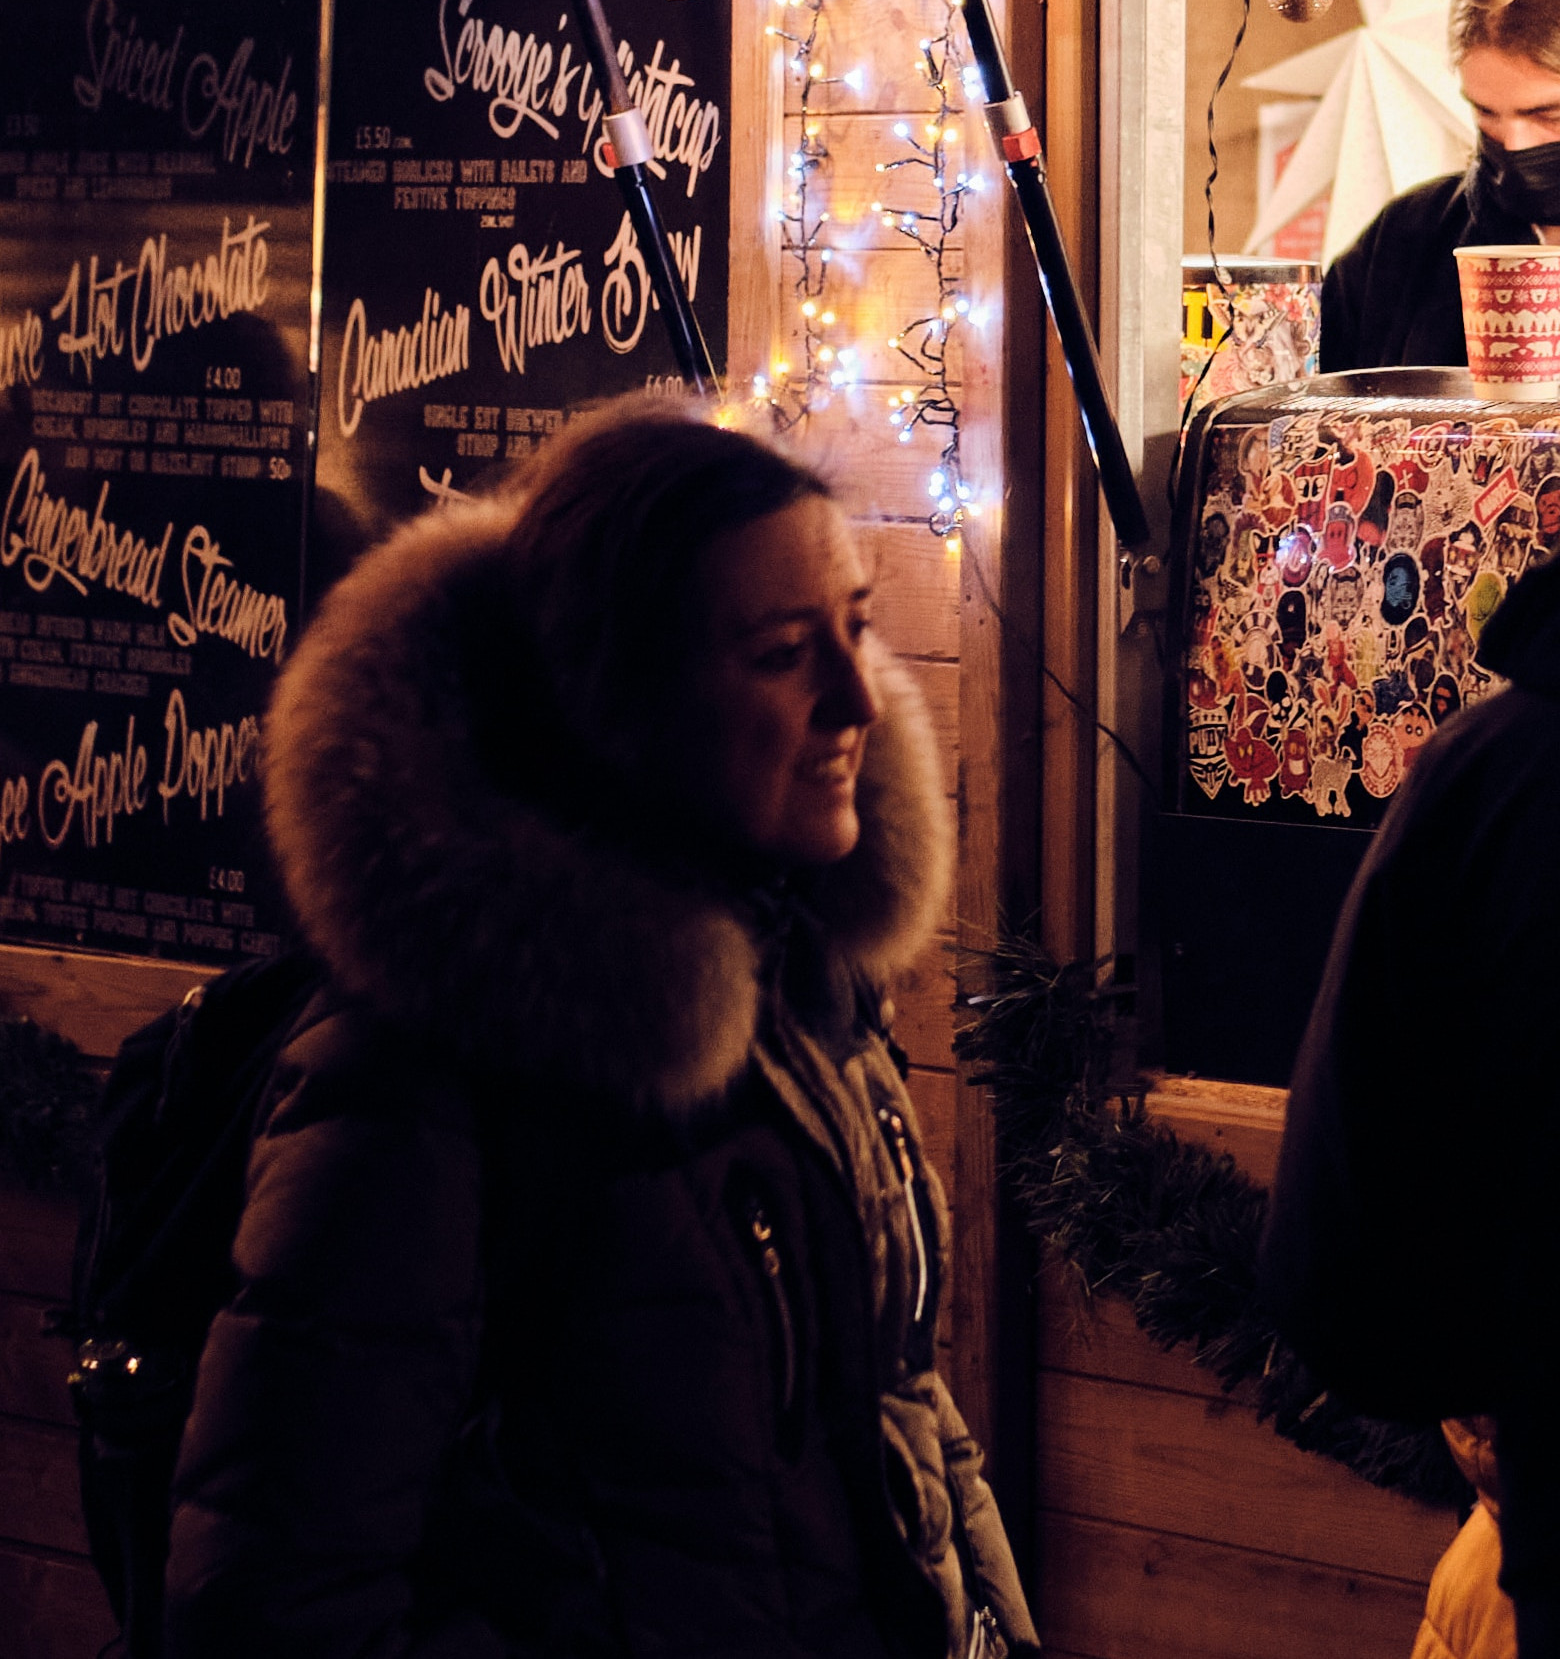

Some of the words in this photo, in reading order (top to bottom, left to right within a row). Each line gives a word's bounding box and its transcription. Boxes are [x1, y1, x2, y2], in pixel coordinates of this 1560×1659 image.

[182, 37, 300, 169] Apple
[392, 159, 454, 184] HORLICKS
[459, 159, 496, 184] WITH
[500, 159, 556, 184] BAILEYS
[561, 159, 589, 184] AND
[393, 186, 449, 210] FESTIVE
[455, 186, 517, 210] TOPPINGS
[50, 253, 139, 386] Hot
[130, 213, 272, 374] Chocolate
[338, 286, 471, 439] Canadian
[479, 241, 593, 375] Winter
[204, 365, 243, 392] £4.00
[166, 523, 289, 667] Steamer
[37, 712, 152, 851] Apple
